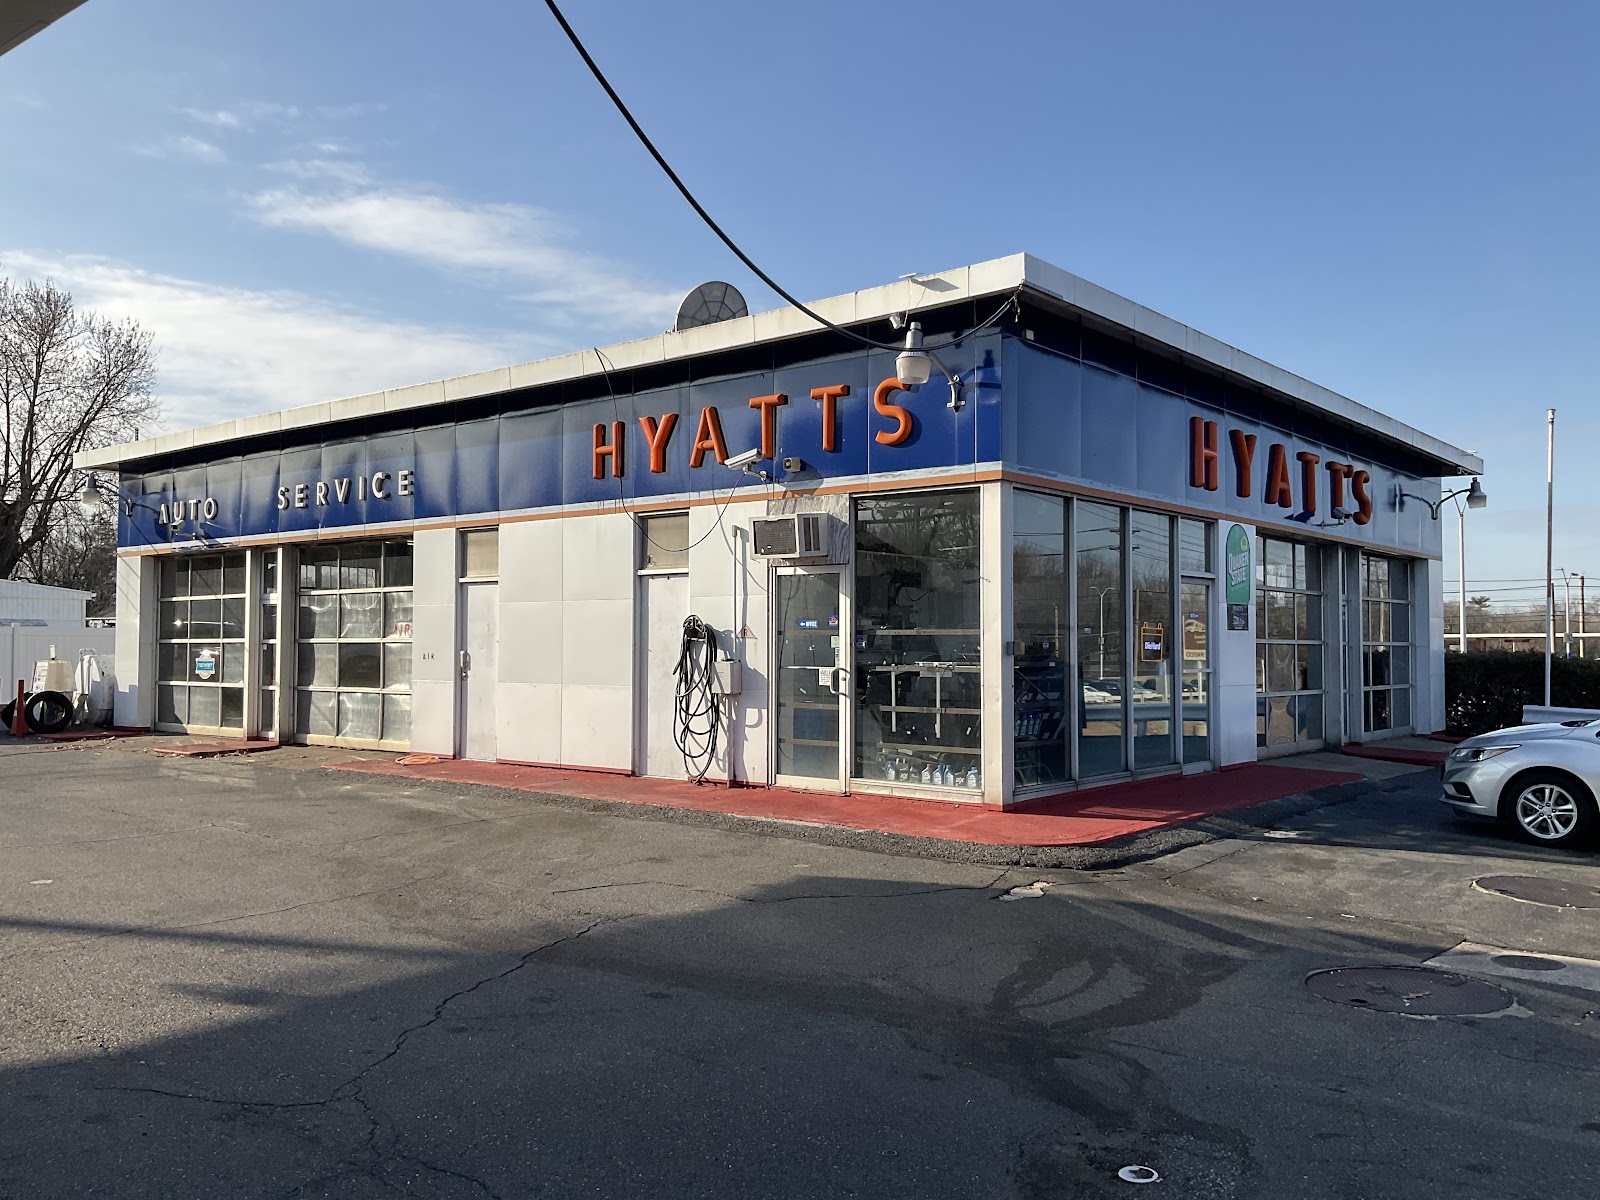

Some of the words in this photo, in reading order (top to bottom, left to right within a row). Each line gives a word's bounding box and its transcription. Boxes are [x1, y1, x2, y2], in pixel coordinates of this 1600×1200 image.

[592, 377, 913, 479] HYATTS
[158, 497, 217, 524] AUTO
[277, 470, 414, 510] SERVICE
[1189, 416, 1371, 525] HYATT'S
[1228, 552, 1248, 574] QUAKER
[1231, 567, 1246, 586] STATE
